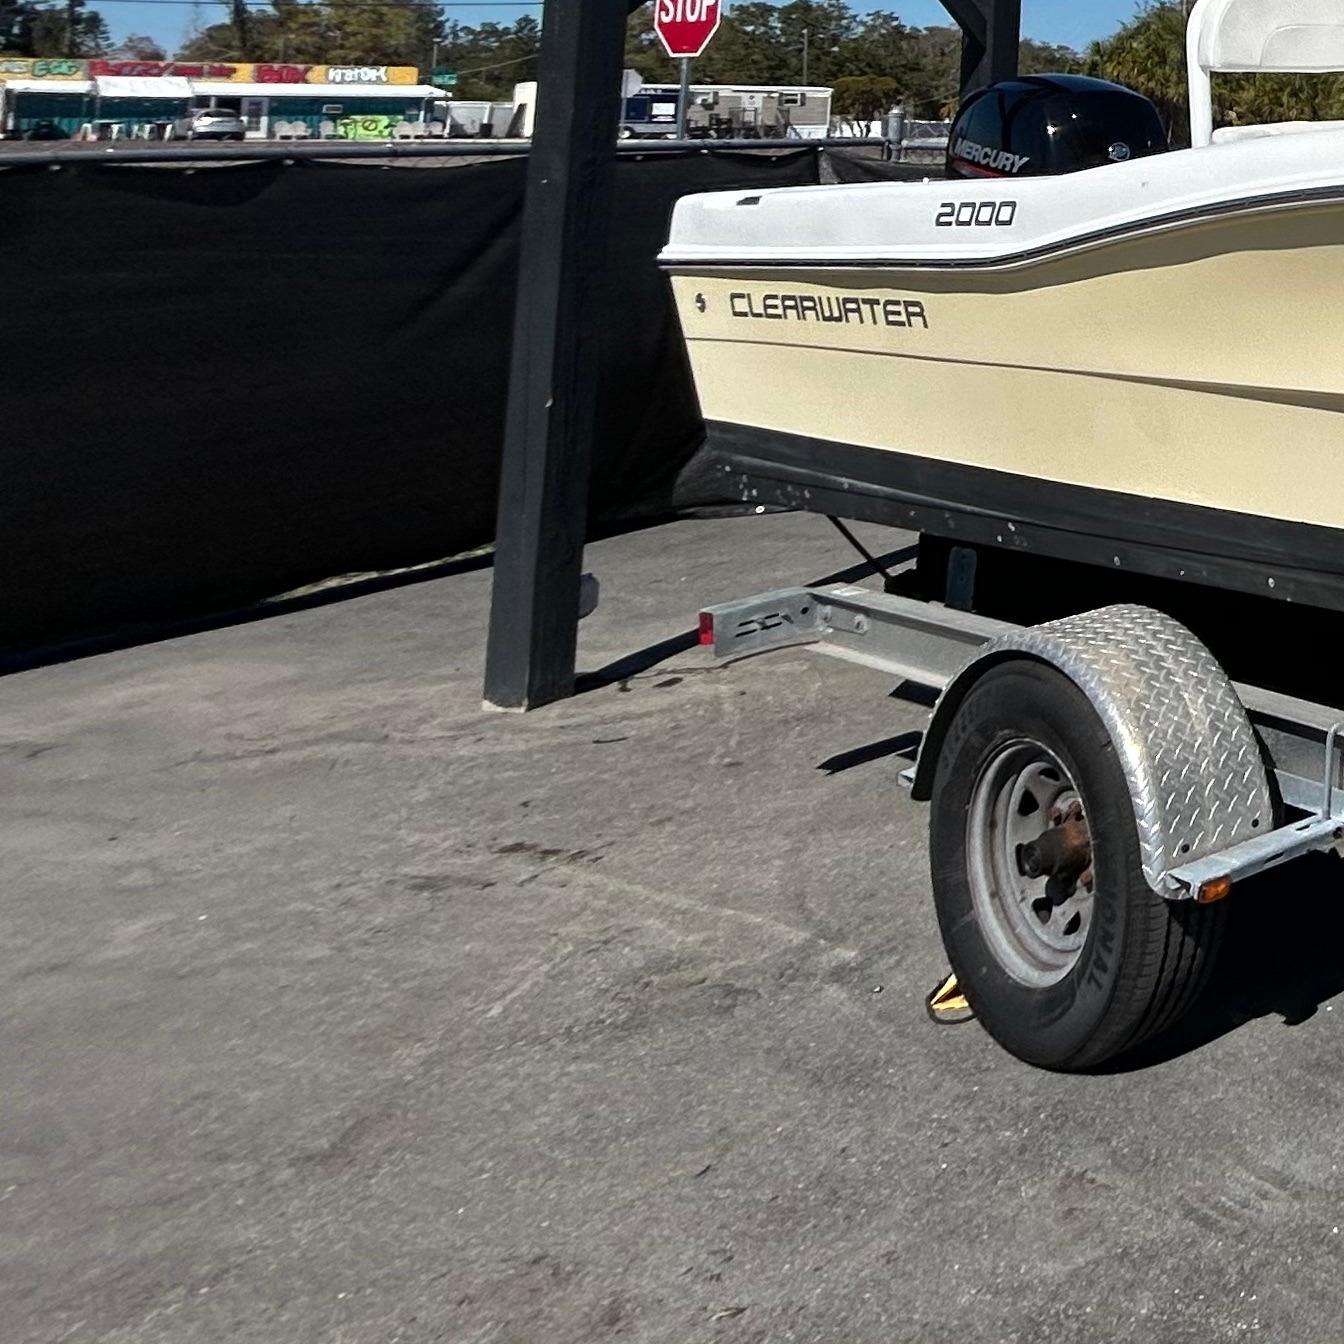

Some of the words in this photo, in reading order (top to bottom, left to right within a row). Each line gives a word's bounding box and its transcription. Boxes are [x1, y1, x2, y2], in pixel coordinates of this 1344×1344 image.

[954, 136, 1031, 174] MERCURY
[935, 200, 1018, 227] 2000
[729, 291, 930, 330] CLEARWATER
